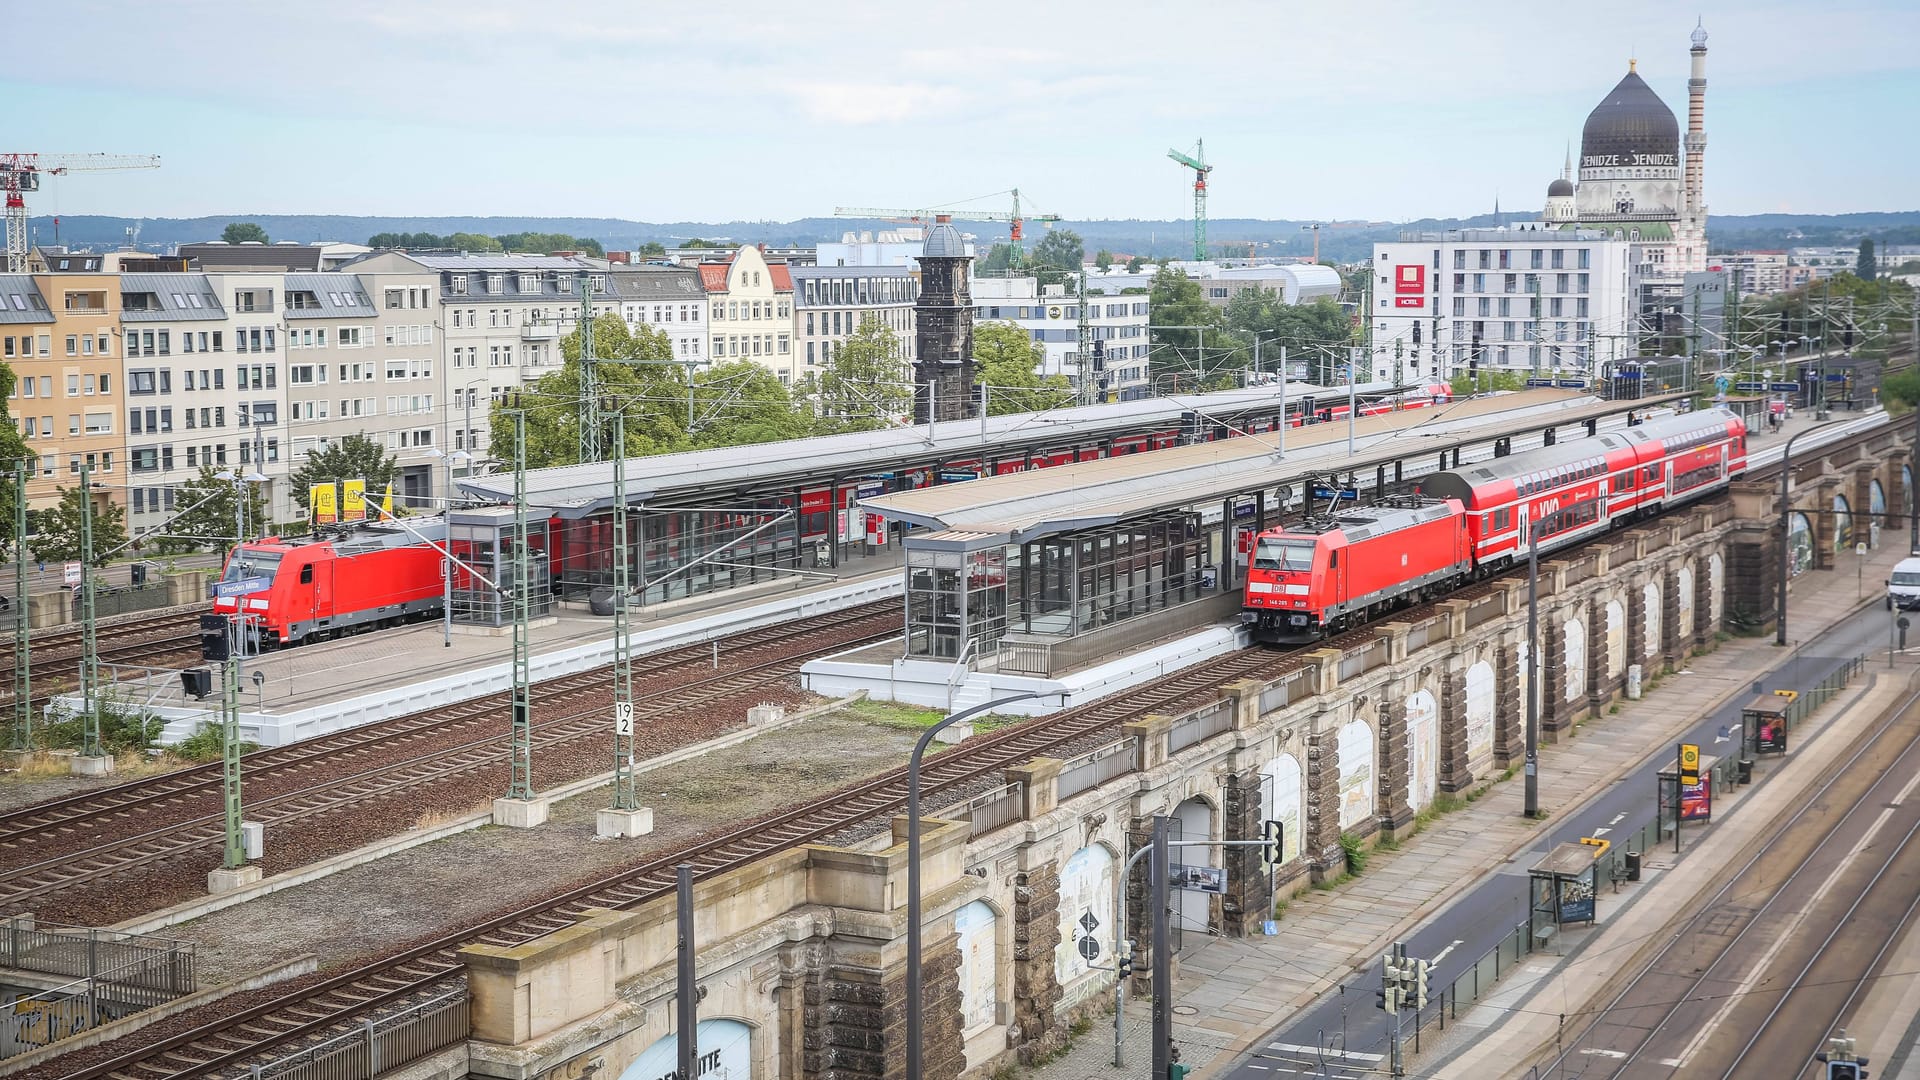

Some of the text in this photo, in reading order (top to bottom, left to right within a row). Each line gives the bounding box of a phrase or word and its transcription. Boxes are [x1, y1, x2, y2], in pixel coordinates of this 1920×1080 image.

[221, 581, 260, 594] Dresden Mitte
[618, 704, 632, 718] 19
[621, 719, 629, 733] 2
[697, 1048, 721, 1077] ITTE
